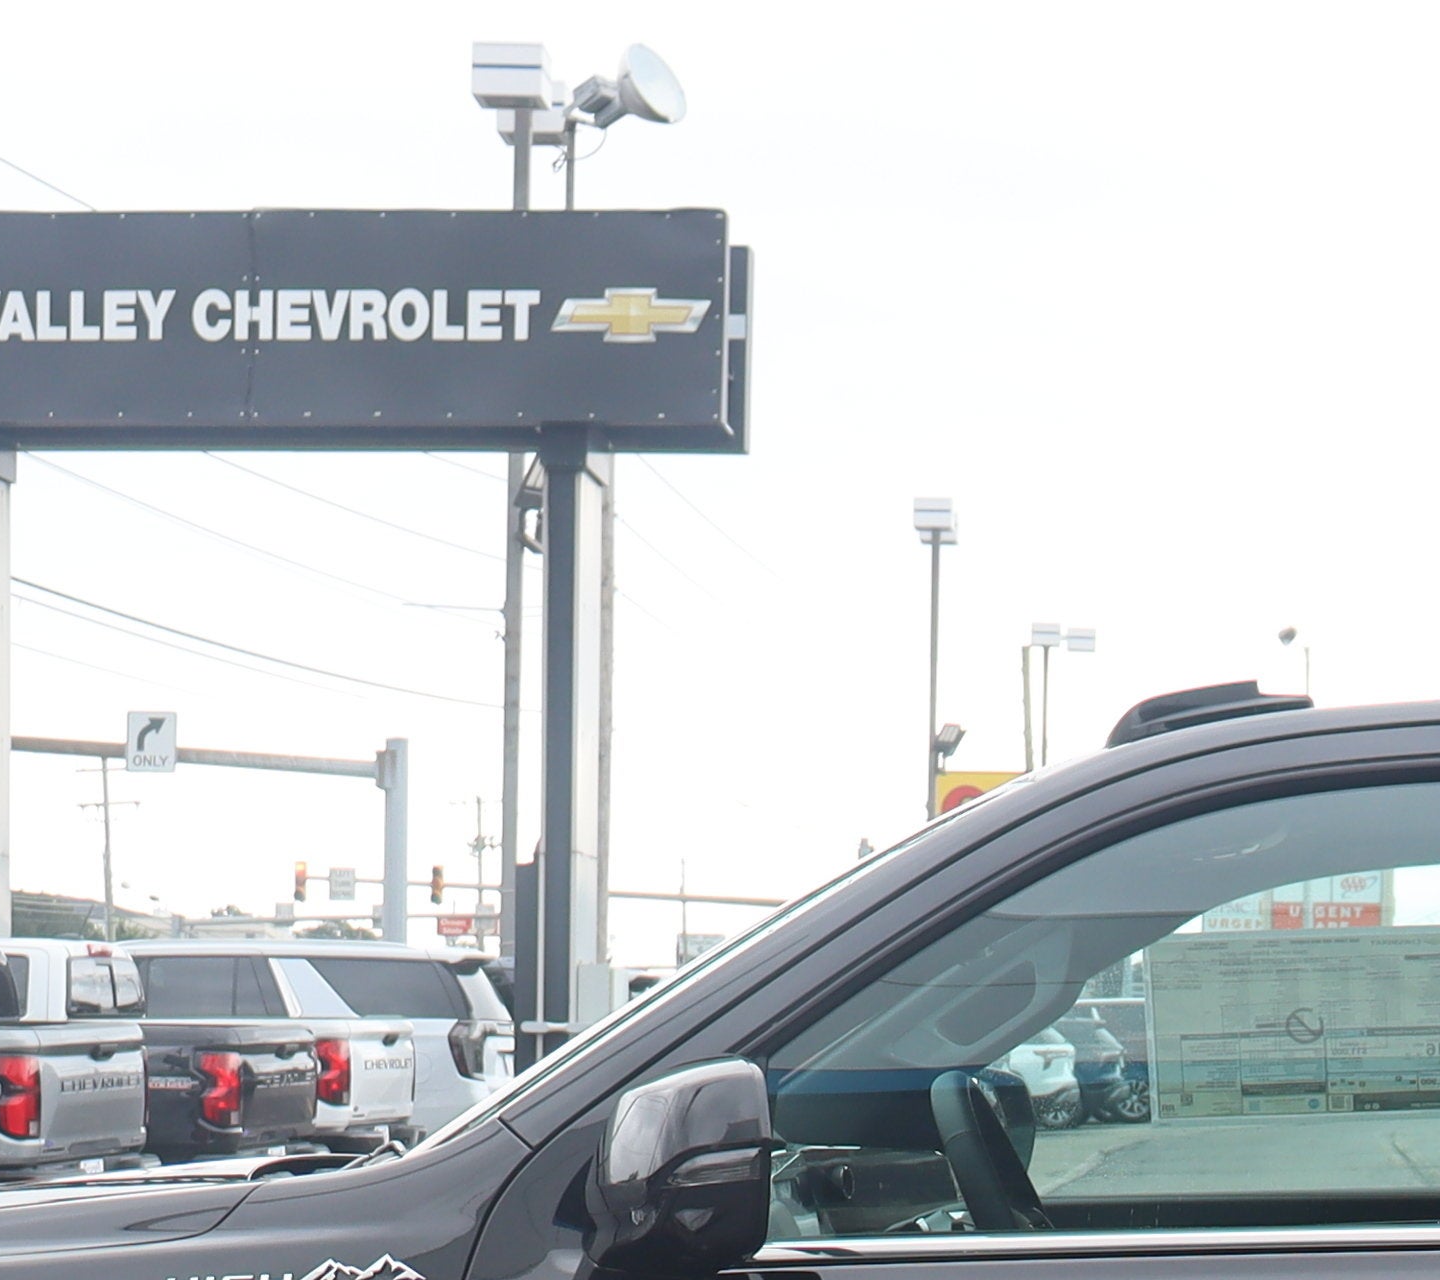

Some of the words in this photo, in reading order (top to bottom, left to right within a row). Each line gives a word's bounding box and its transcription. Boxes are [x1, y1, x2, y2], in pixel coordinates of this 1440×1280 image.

[191, 288, 541, 343] CHEVROLET
[132, 754, 170, 769] ONLY
[1289, 905, 1363, 918] UGENT
